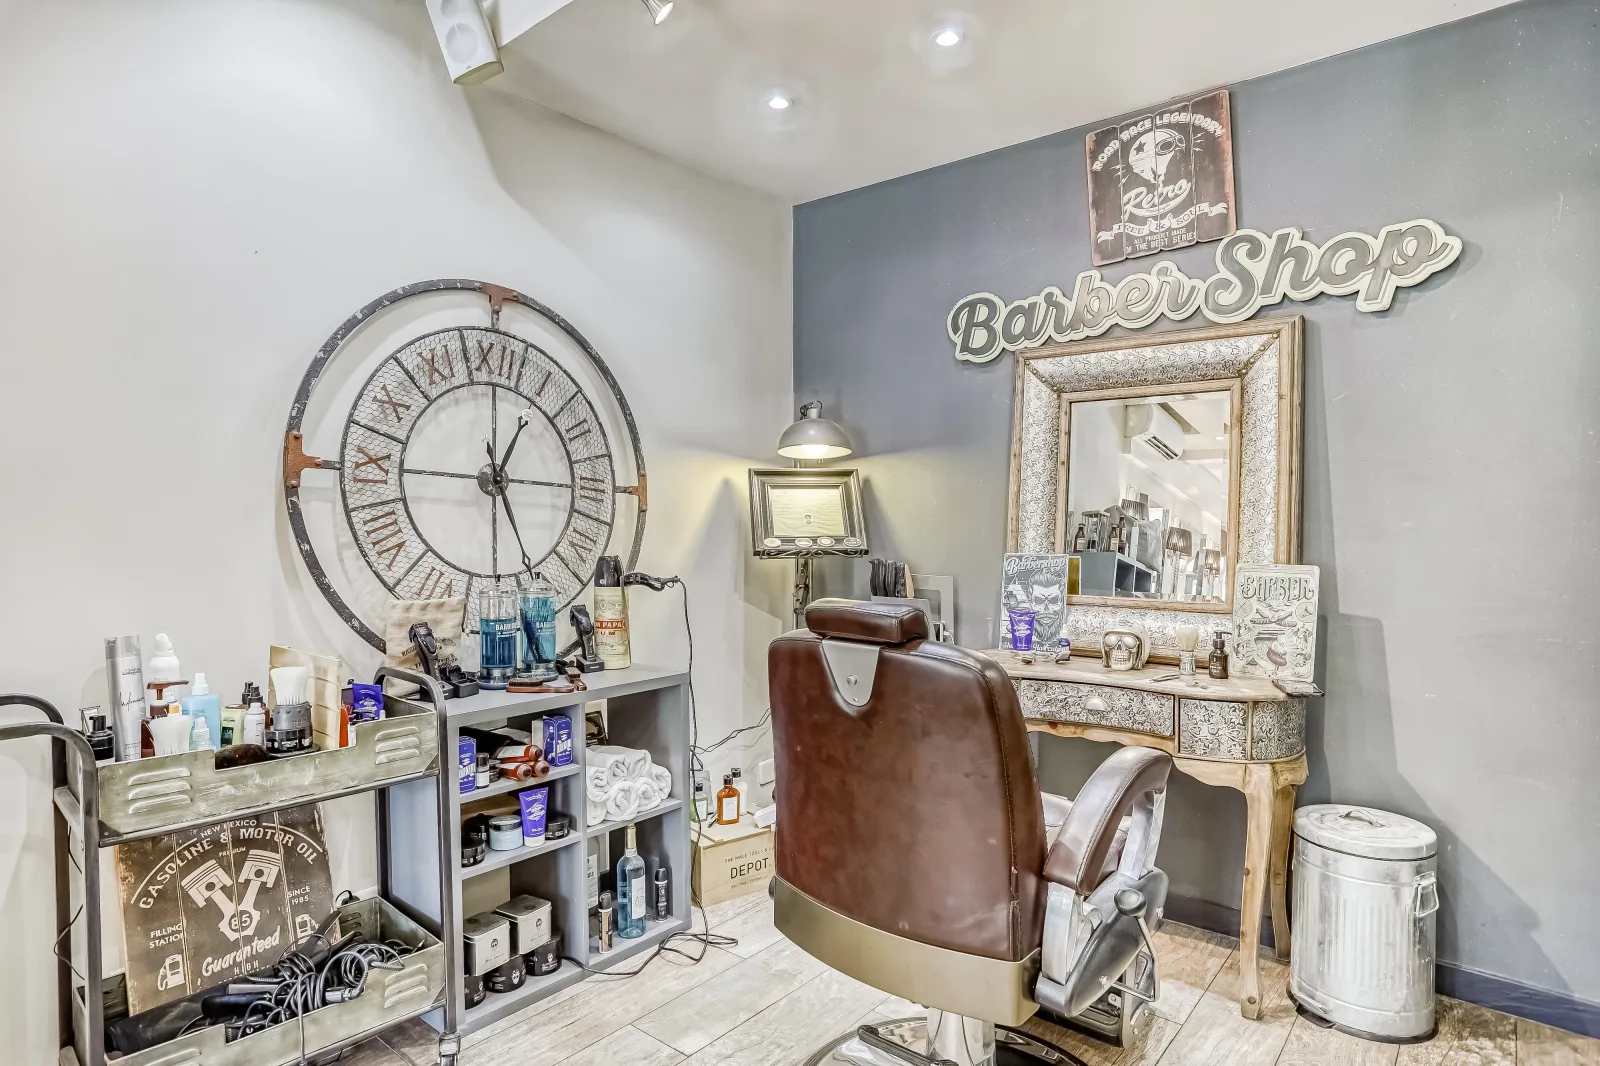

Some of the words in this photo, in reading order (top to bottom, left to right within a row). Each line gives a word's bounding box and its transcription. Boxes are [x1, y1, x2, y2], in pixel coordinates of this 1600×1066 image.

[1092, 139, 1120, 172] ROAD
[1120, 120, 1152, 142] RACE
[1156, 112, 1226, 137] LEGENDARY
[1121, 178, 1192, 222] Retro
[1116, 224, 1145, 236] FREE
[1154, 222, 1166, 231] &
[1176, 205, 1205, 226] SOUL
[1135, 242, 1149, 251] THE
[1150, 237, 1169, 248] BEST
[1172, 231, 1197, 245] SERIES
[1146, 231, 1169, 242] PRODUCT
[1171, 227, 1187, 237] MADE
[948, 262, 1204, 362] Barber
[1201, 220, 1460, 311] Shop
[1006, 556, 1066, 576] Barbershop
[1239, 576, 1316, 602] BARBER
[200, 824, 221, 839] NEW
[223, 819, 257, 829] MEXICO
[139, 836, 214, 909] GASOLINE
[219, 832, 233, 843] &
[239, 827, 294, 847] MOTOR
[296, 841, 319, 865] OIL
[730, 857, 769, 880] DEPOT
[287, 885, 311, 898] SINCE
[291, 894, 309, 906] 1985
[150, 923, 183, 939] FILLING
[228, 913, 252, 931] 85
[201, 924, 281, 977] Guaranteed
